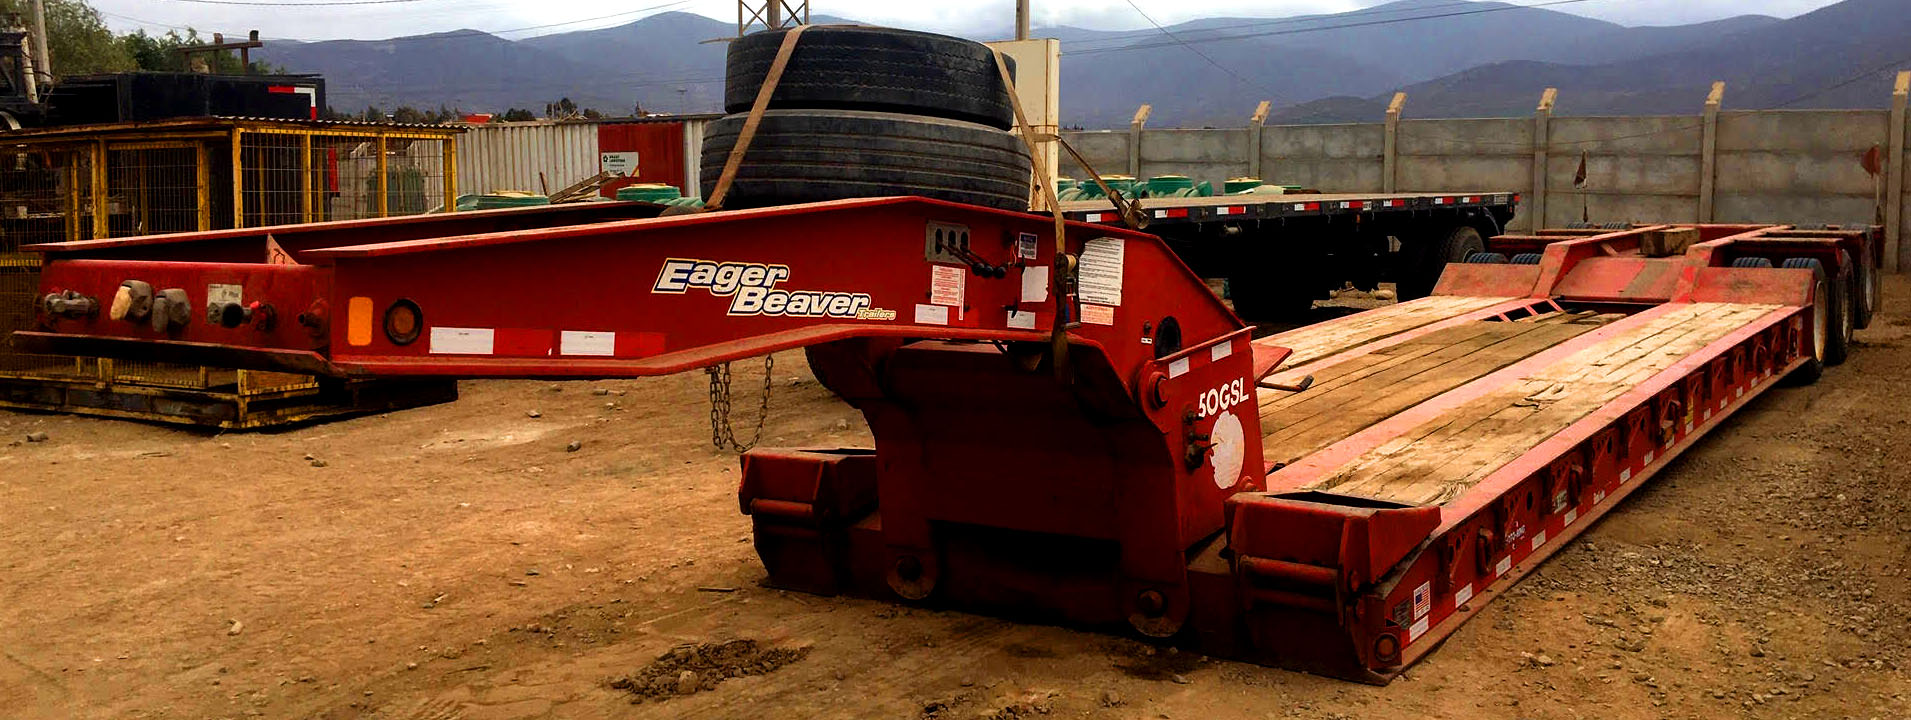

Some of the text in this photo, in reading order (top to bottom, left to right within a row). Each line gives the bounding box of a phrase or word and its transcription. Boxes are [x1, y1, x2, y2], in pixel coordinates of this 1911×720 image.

[653, 259, 789, 295] Eager
[730, 287, 870, 317] Beaver
[857, 308, 896, 320] Trailers
[1198, 377, 1248, 418] 50GSL
